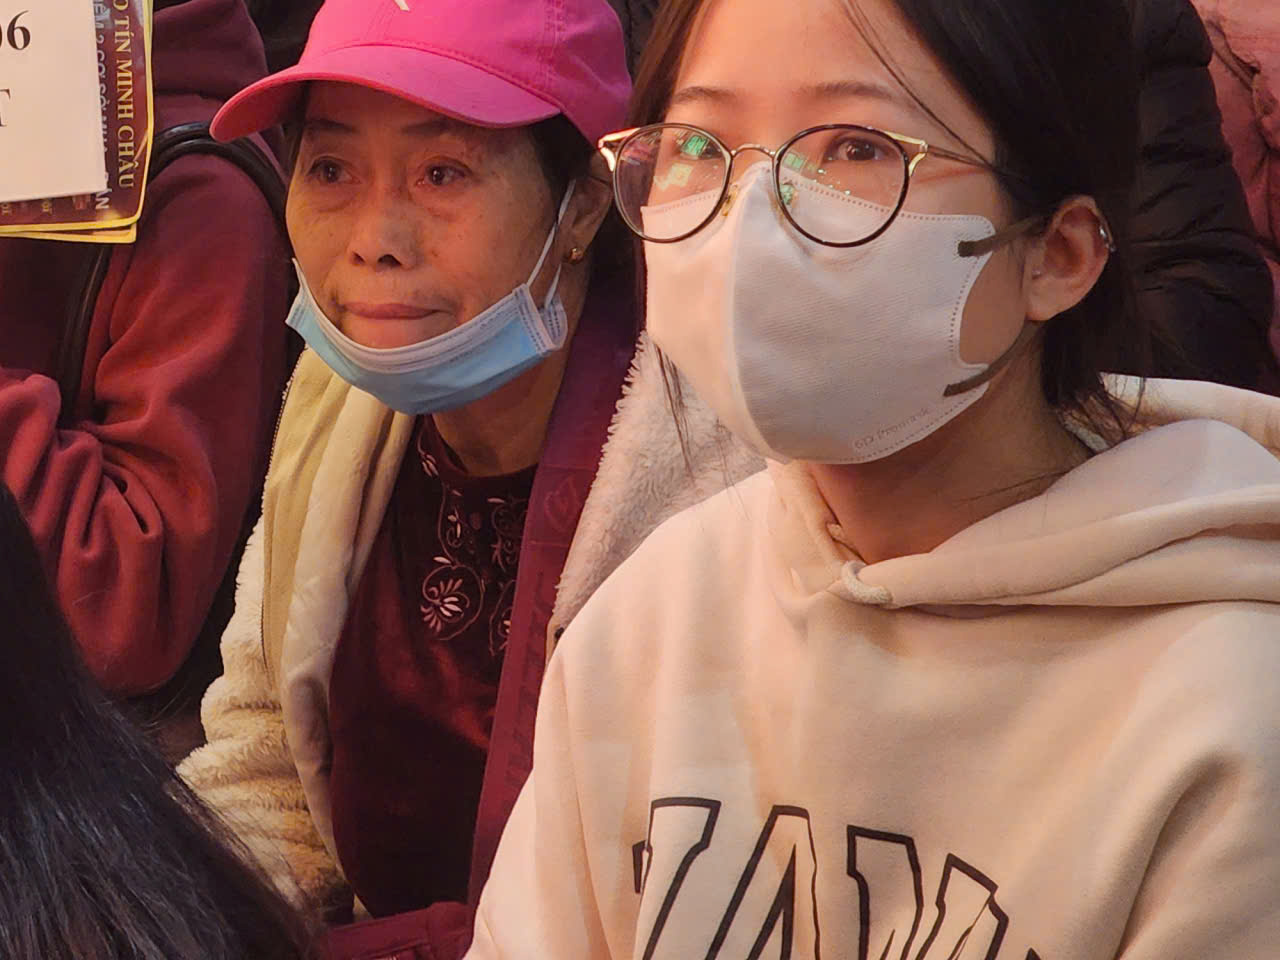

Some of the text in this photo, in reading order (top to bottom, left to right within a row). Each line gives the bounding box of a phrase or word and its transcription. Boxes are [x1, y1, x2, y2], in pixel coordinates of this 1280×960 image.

[114, 15, 134, 53] TÍN
[116, 58, 134, 120] MINH
[117, 125, 139, 188] CHÂU
